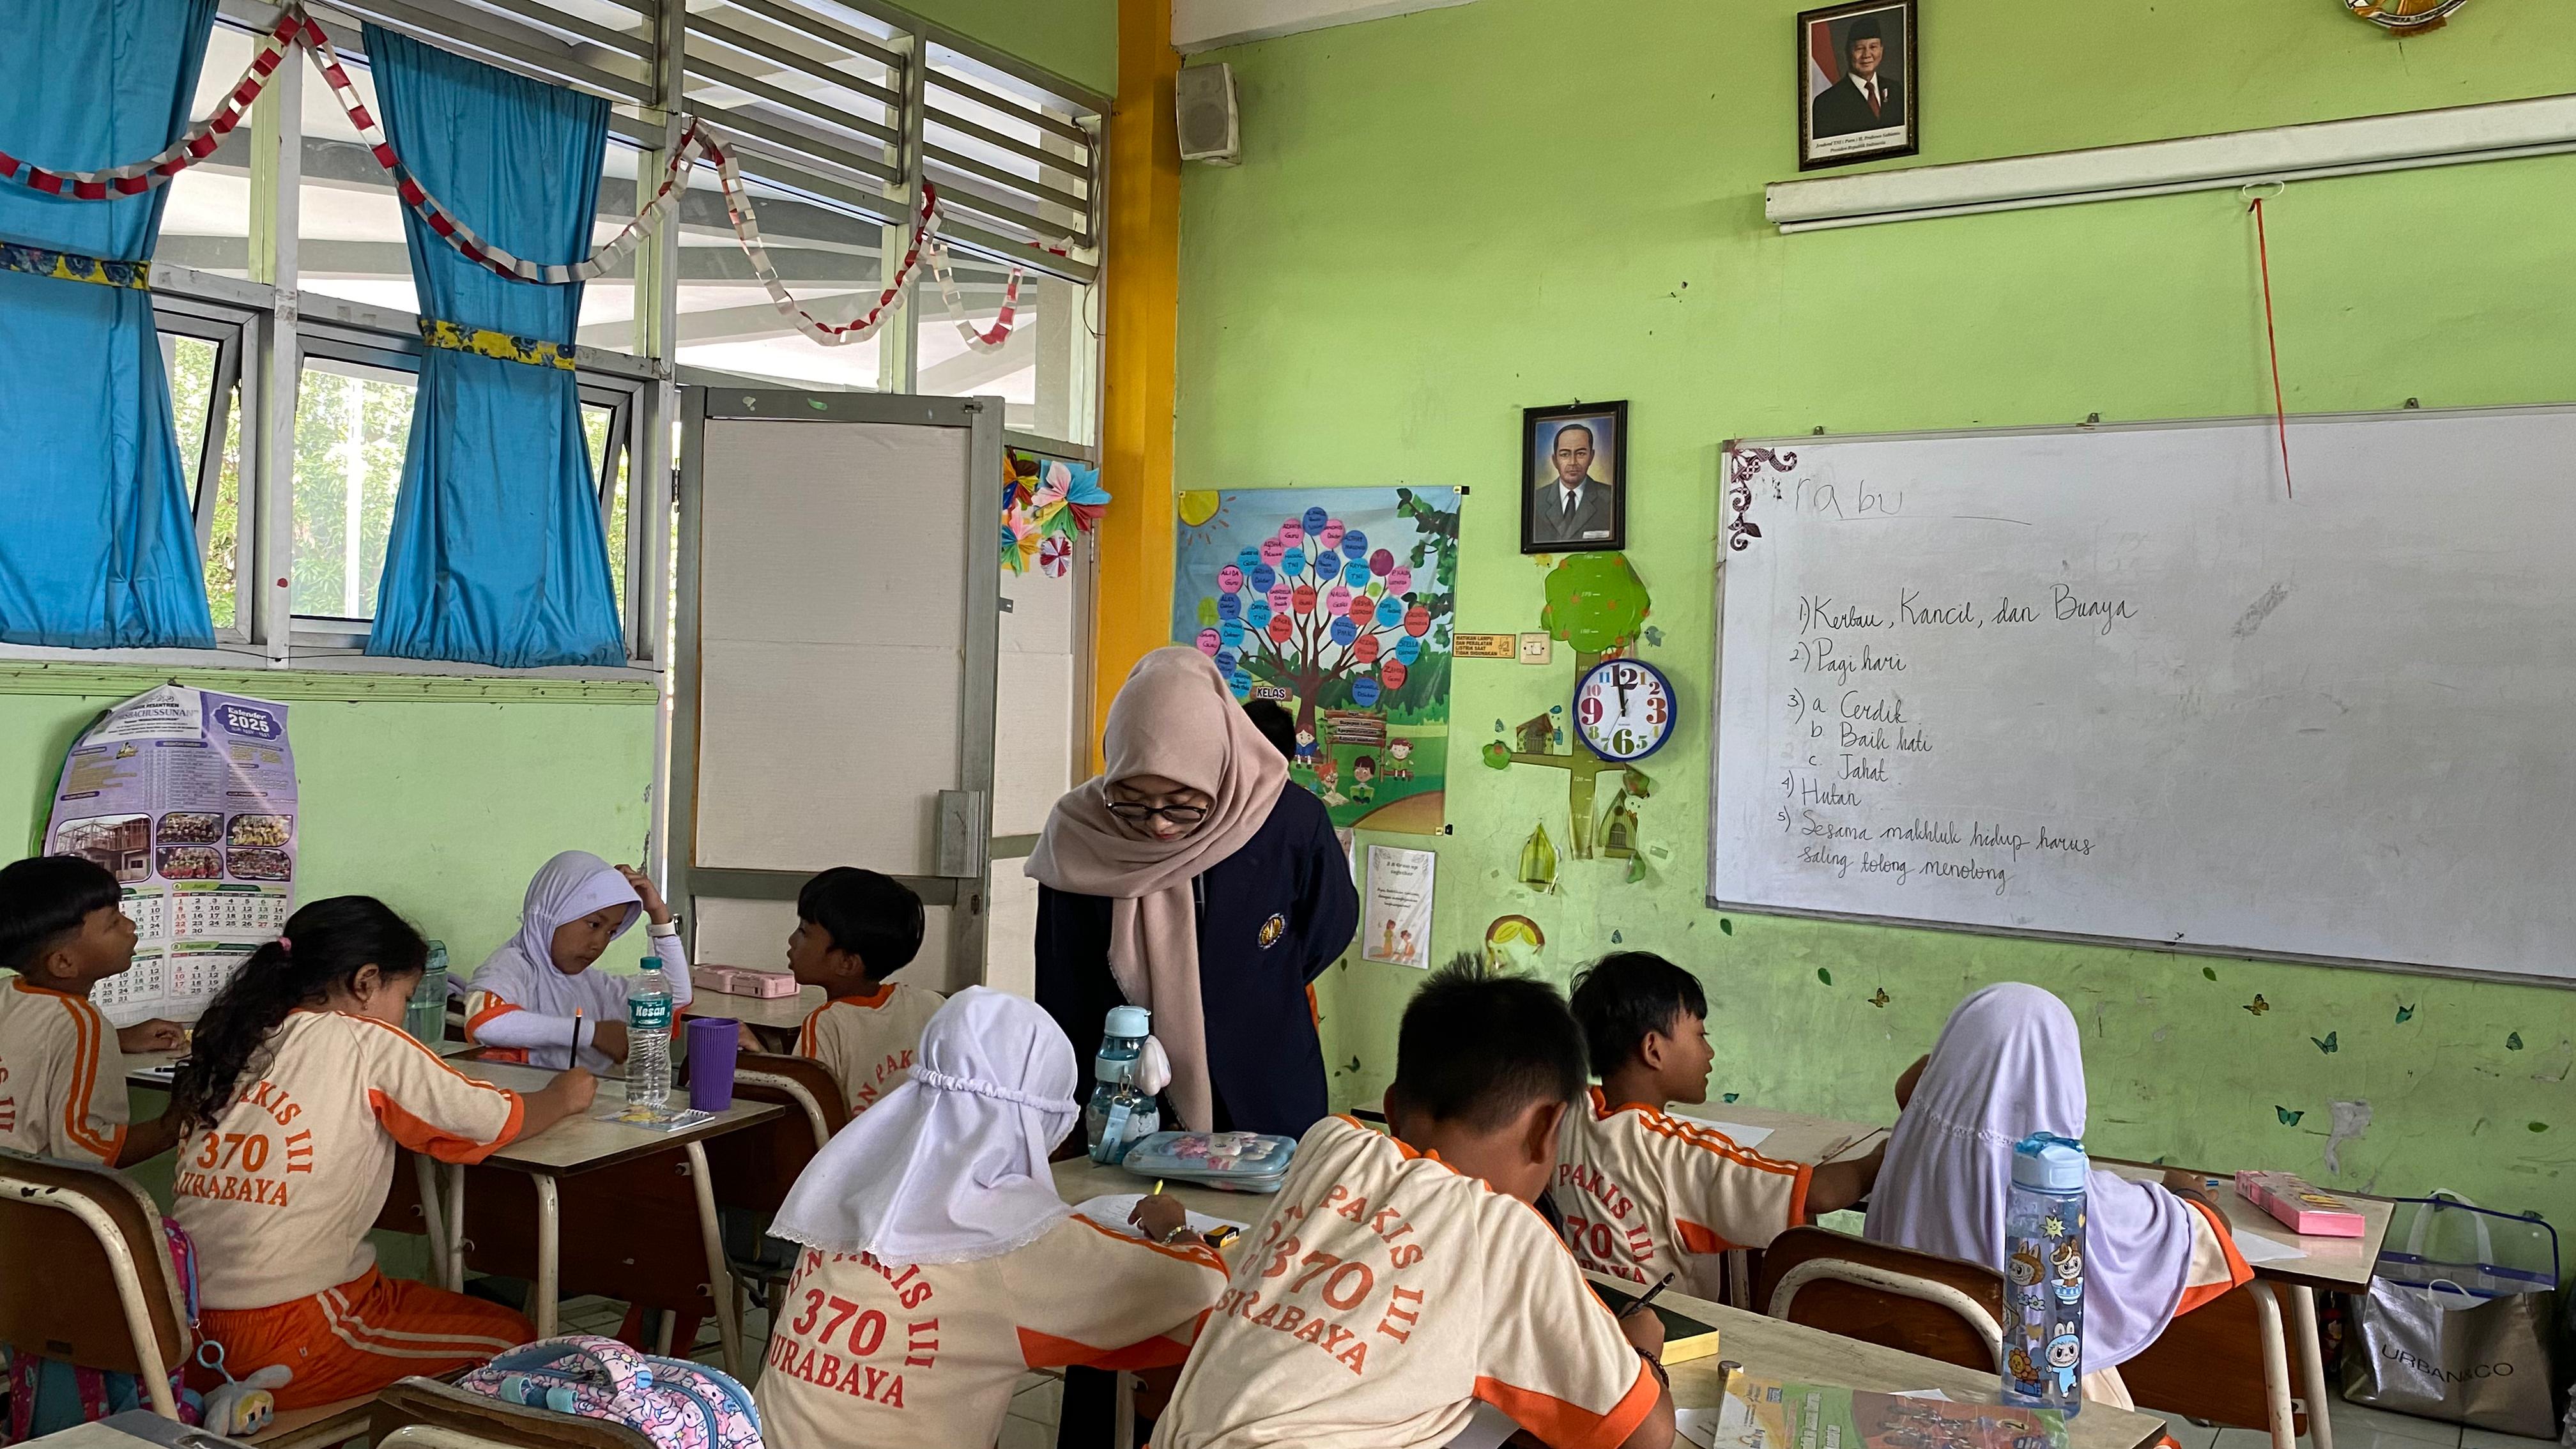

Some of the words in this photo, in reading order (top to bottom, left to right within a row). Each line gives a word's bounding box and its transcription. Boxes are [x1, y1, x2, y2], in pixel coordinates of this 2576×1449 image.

[1795, 477, 1903, 518] rabu
[1991, 597, 2040, 624] dan
[2050, 583, 2138, 635] Buaya
[1813, 637, 1857, 687] Pagi
[1861, 645, 1906, 671] hari
[1586, 684, 1601, 696] 10
[1599, 671, 1610, 683] 11
[1610, 664, 1638, 690] 12
[1639, 671, 1646, 685] 1
[1649, 682, 1660, 694] 2
[1257, 688, 1285, 698] KELAS
[1841, 690, 1908, 724] Cerdik
[227, 707, 266, 719] Kalender
[228, 714, 270, 733] 2025
[1581, 698, 1603, 725] 9
[1646, 698, 1667, 724] 3
[1588, 726, 1599, 739] 8
[1601, 737, 1610, 751] 7
[1613, 728, 1634, 755] 6
[1636, 735, 1648, 749] 5
[1840, 721, 1889, 749] Baik
[1897, 726, 1933, 752] hati
[1837, 754, 1888, 782] Jahat
[1802, 778, 1862, 806] Hutan
[1802, 809, 1873, 841] Sesama
[1880, 818, 1961, 845] makhluk
[1970, 821, 2030, 862] hidup
[2036, 826, 2096, 855] harus
[1797, 845, 1853, 878] saling
[1860, 851, 1915, 885] tolong
[1919, 858, 2016, 896] menolong
[636, 1006, 666, 1017] Kesan
[197, 1131, 269, 1172] 370
[1559, 1163, 1633, 1220] PAKIS
[1625, 1223, 1654, 1263] III
[1567, 1215, 1613, 1259] 70
[1261, 1235, 1374, 1312] 370
[1319, 1184, 1424, 1269] PAKIS
[1376, 1284, 1424, 1344] III
[793, 1288, 887, 1356] 370
[905, 1317, 939, 1368] III
[768, 1331, 904, 1409] URABAYA
